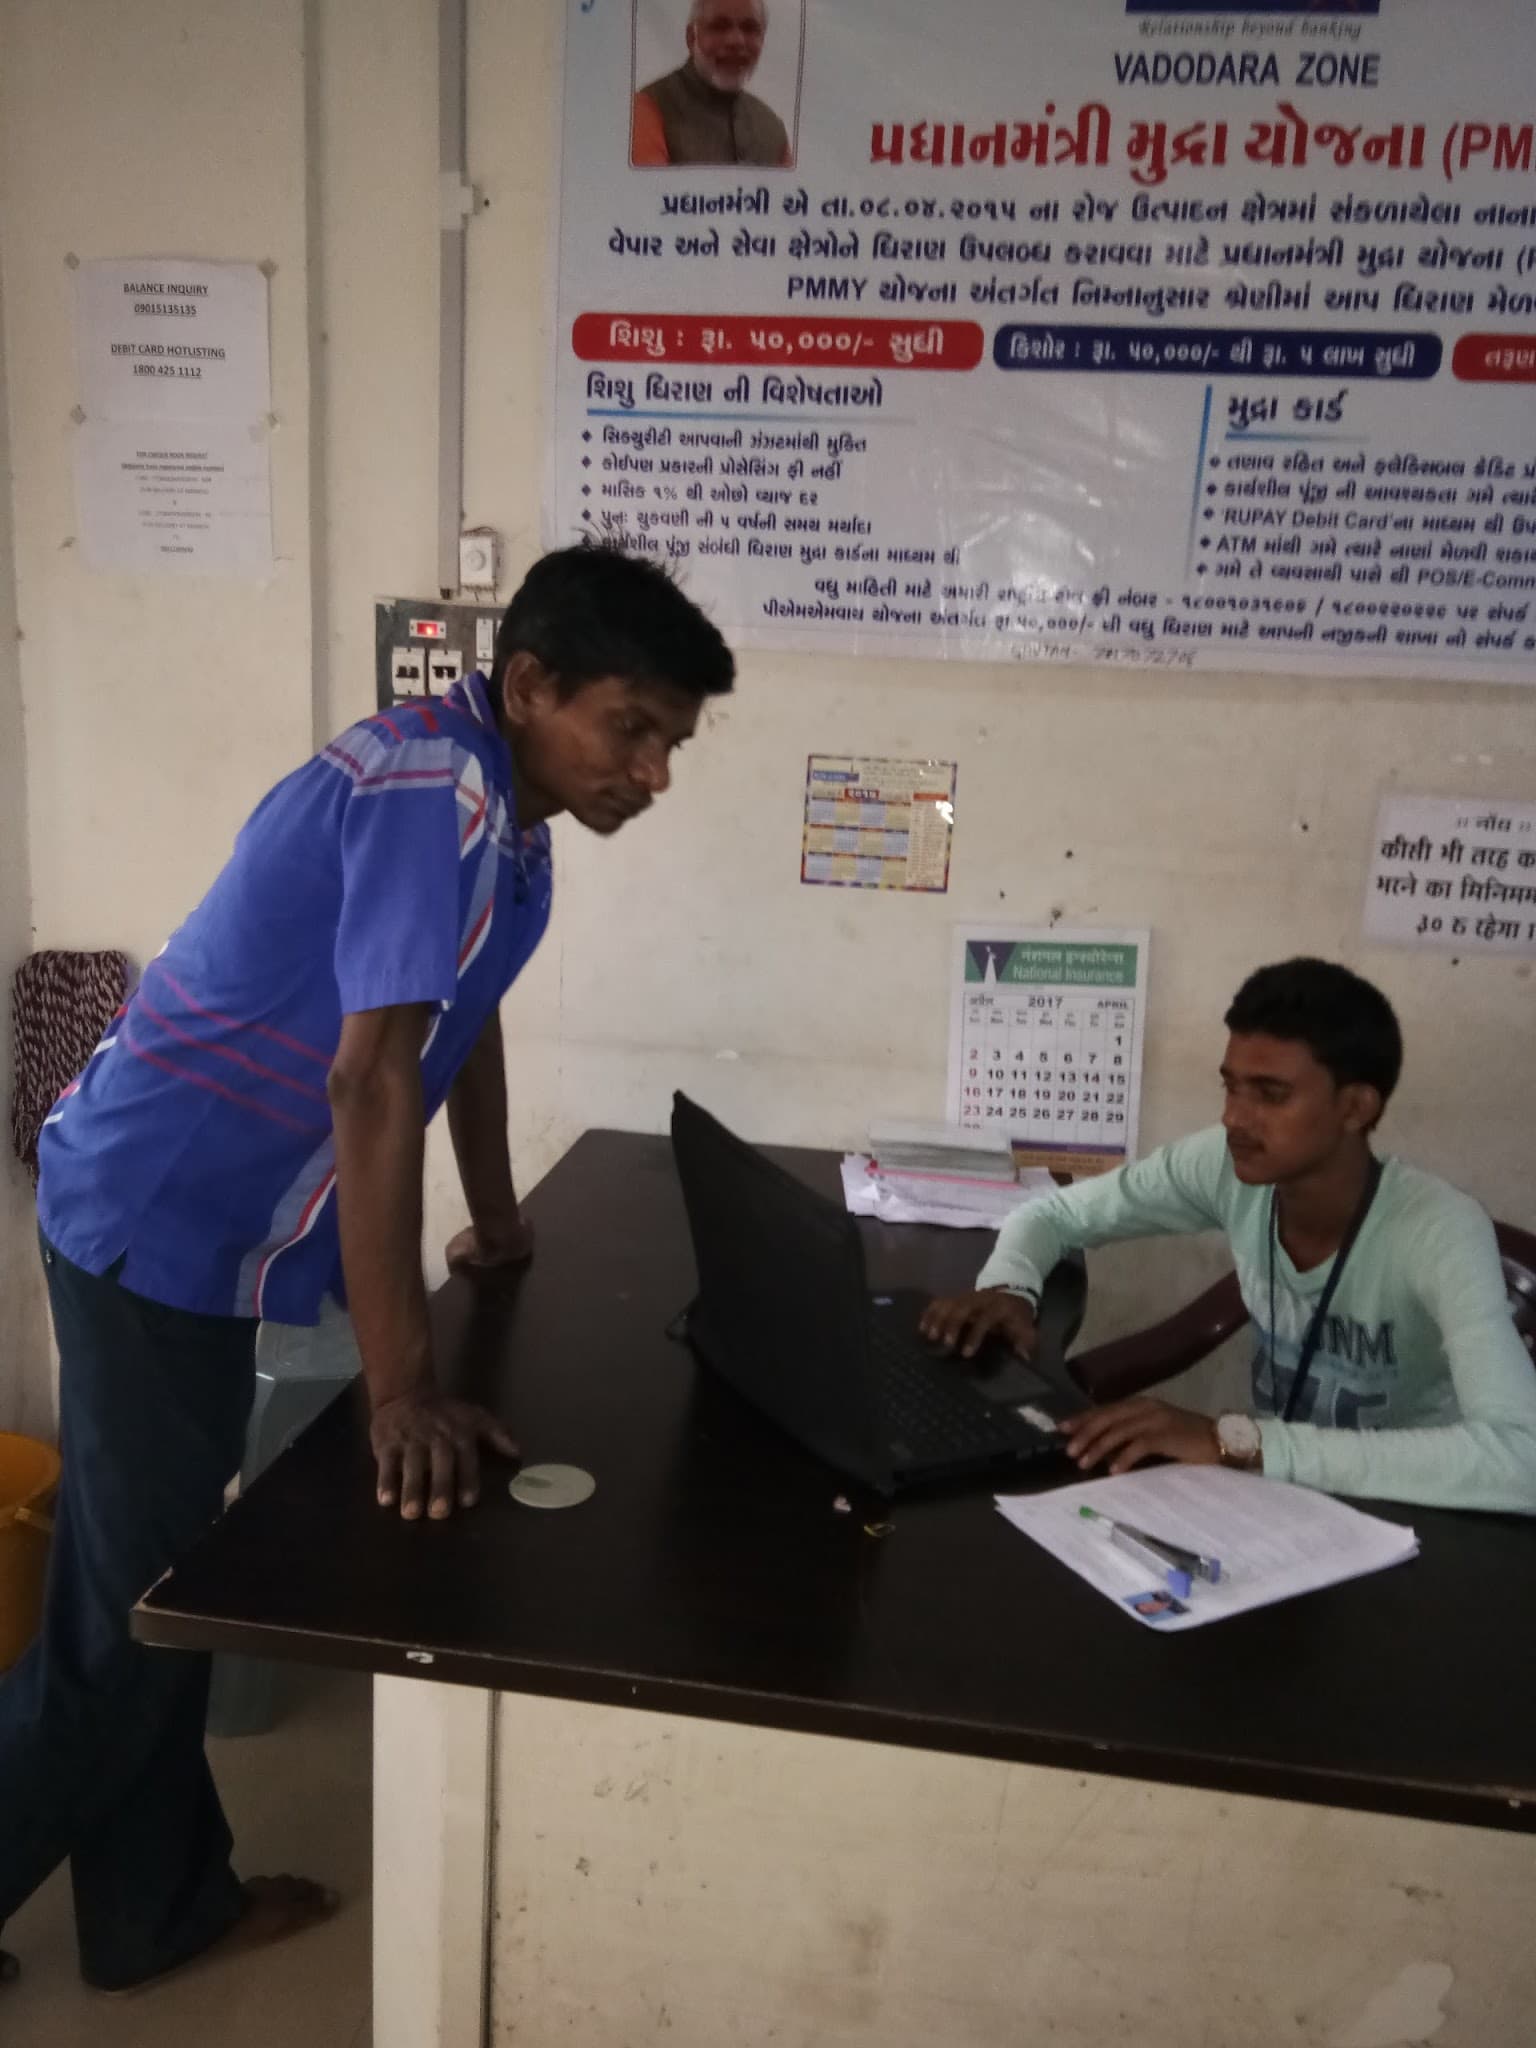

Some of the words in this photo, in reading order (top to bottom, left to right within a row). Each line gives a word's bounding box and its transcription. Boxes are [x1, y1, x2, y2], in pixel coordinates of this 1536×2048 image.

[1113, 51, 1280, 87] VADODARA
[1295, 51, 1381, 89] ZONE
[869, 102, 1112, 168] પ્રધાનમંત્રી
[1127, 120, 1228, 186] મુદ્રા
[1245, 101, 1426, 170] યોજના
[659, 186, 770, 216] પ્રધાનમંત્રી
[1028, 199, 1060, 223] ના
[1071, 190, 1120, 223] રોજ
[607, 225, 663, 258] વેપાર
[674, 227, 720, 258] અને
[731, 227, 776, 258] સેવા
[872, 230, 947, 262] ધિરાણ
[1165, 234, 1210, 267] માટે
[123, 283, 165, 295] BALANCE
[167, 284, 209, 296] INQUIRY
[787, 275, 869, 301] PMMY
[878, 272, 957, 303] યોજના
[133, 303, 197, 316] 09015135135
[111, 344, 136, 355] DEBIT
[138, 345, 165, 356] CARD
[167, 346, 226, 360] HOTLISTING
[133, 364, 154, 376] 1800
[157, 366, 176, 377] 425
[179, 366, 202, 378] 1112
[586, 370, 636, 408] શિશુ
[645, 372, 713, 403] ધિરાણ
[723, 374, 750, 404] ની
[762, 375, 883, 408] વિશેષતાઓ
[1291, 509, 1339, 529] Debit
[1215, 534, 1257, 553] ATM
[1028, 996, 1064, 1009] 2017
[1115, 1035, 1122, 1046] 1
[969, 1049, 978, 1060] 2
[992, 1050, 1001, 1061] 3
[1015, 1051, 1024, 1061] 4
[1039, 1051, 1048, 1063] 5
[1064, 1053, 1072, 1064] 6
[1088, 1053, 1097, 1064] 7
[1113, 1055, 1122, 1066] 8
[969, 1067, 977, 1078] 9
[987, 1069, 1004, 1080] 10
[1011, 1069, 1027, 1080] 11
[1035, 1070, 1051, 1082] 12
[1059, 1071, 1076, 1083] 13
[1083, 1072, 1100, 1083] 14
[1108, 1073, 1125, 1085] 15
[964, 1086, 981, 1097] 16
[987, 1087, 1003, 1098] 17
[1010, 1088, 1027, 1099] 18
[1034, 1089, 1050, 1100] 19
[1058, 1090, 1075, 1101] 20
[1083, 1091, 1099, 1102] 21
[1106, 1093, 1124, 1104] 22
[963, 1105, 981, 1116] 23
[986, 1106, 1003, 1117] 24
[1009, 1107, 1026, 1118] 25
[1033, 1108, 1050, 1119] 26
[1056, 1110, 1074, 1121] 27
[1081, 1111, 1099, 1122] 28
[1106, 1112, 1124, 1123] 29
